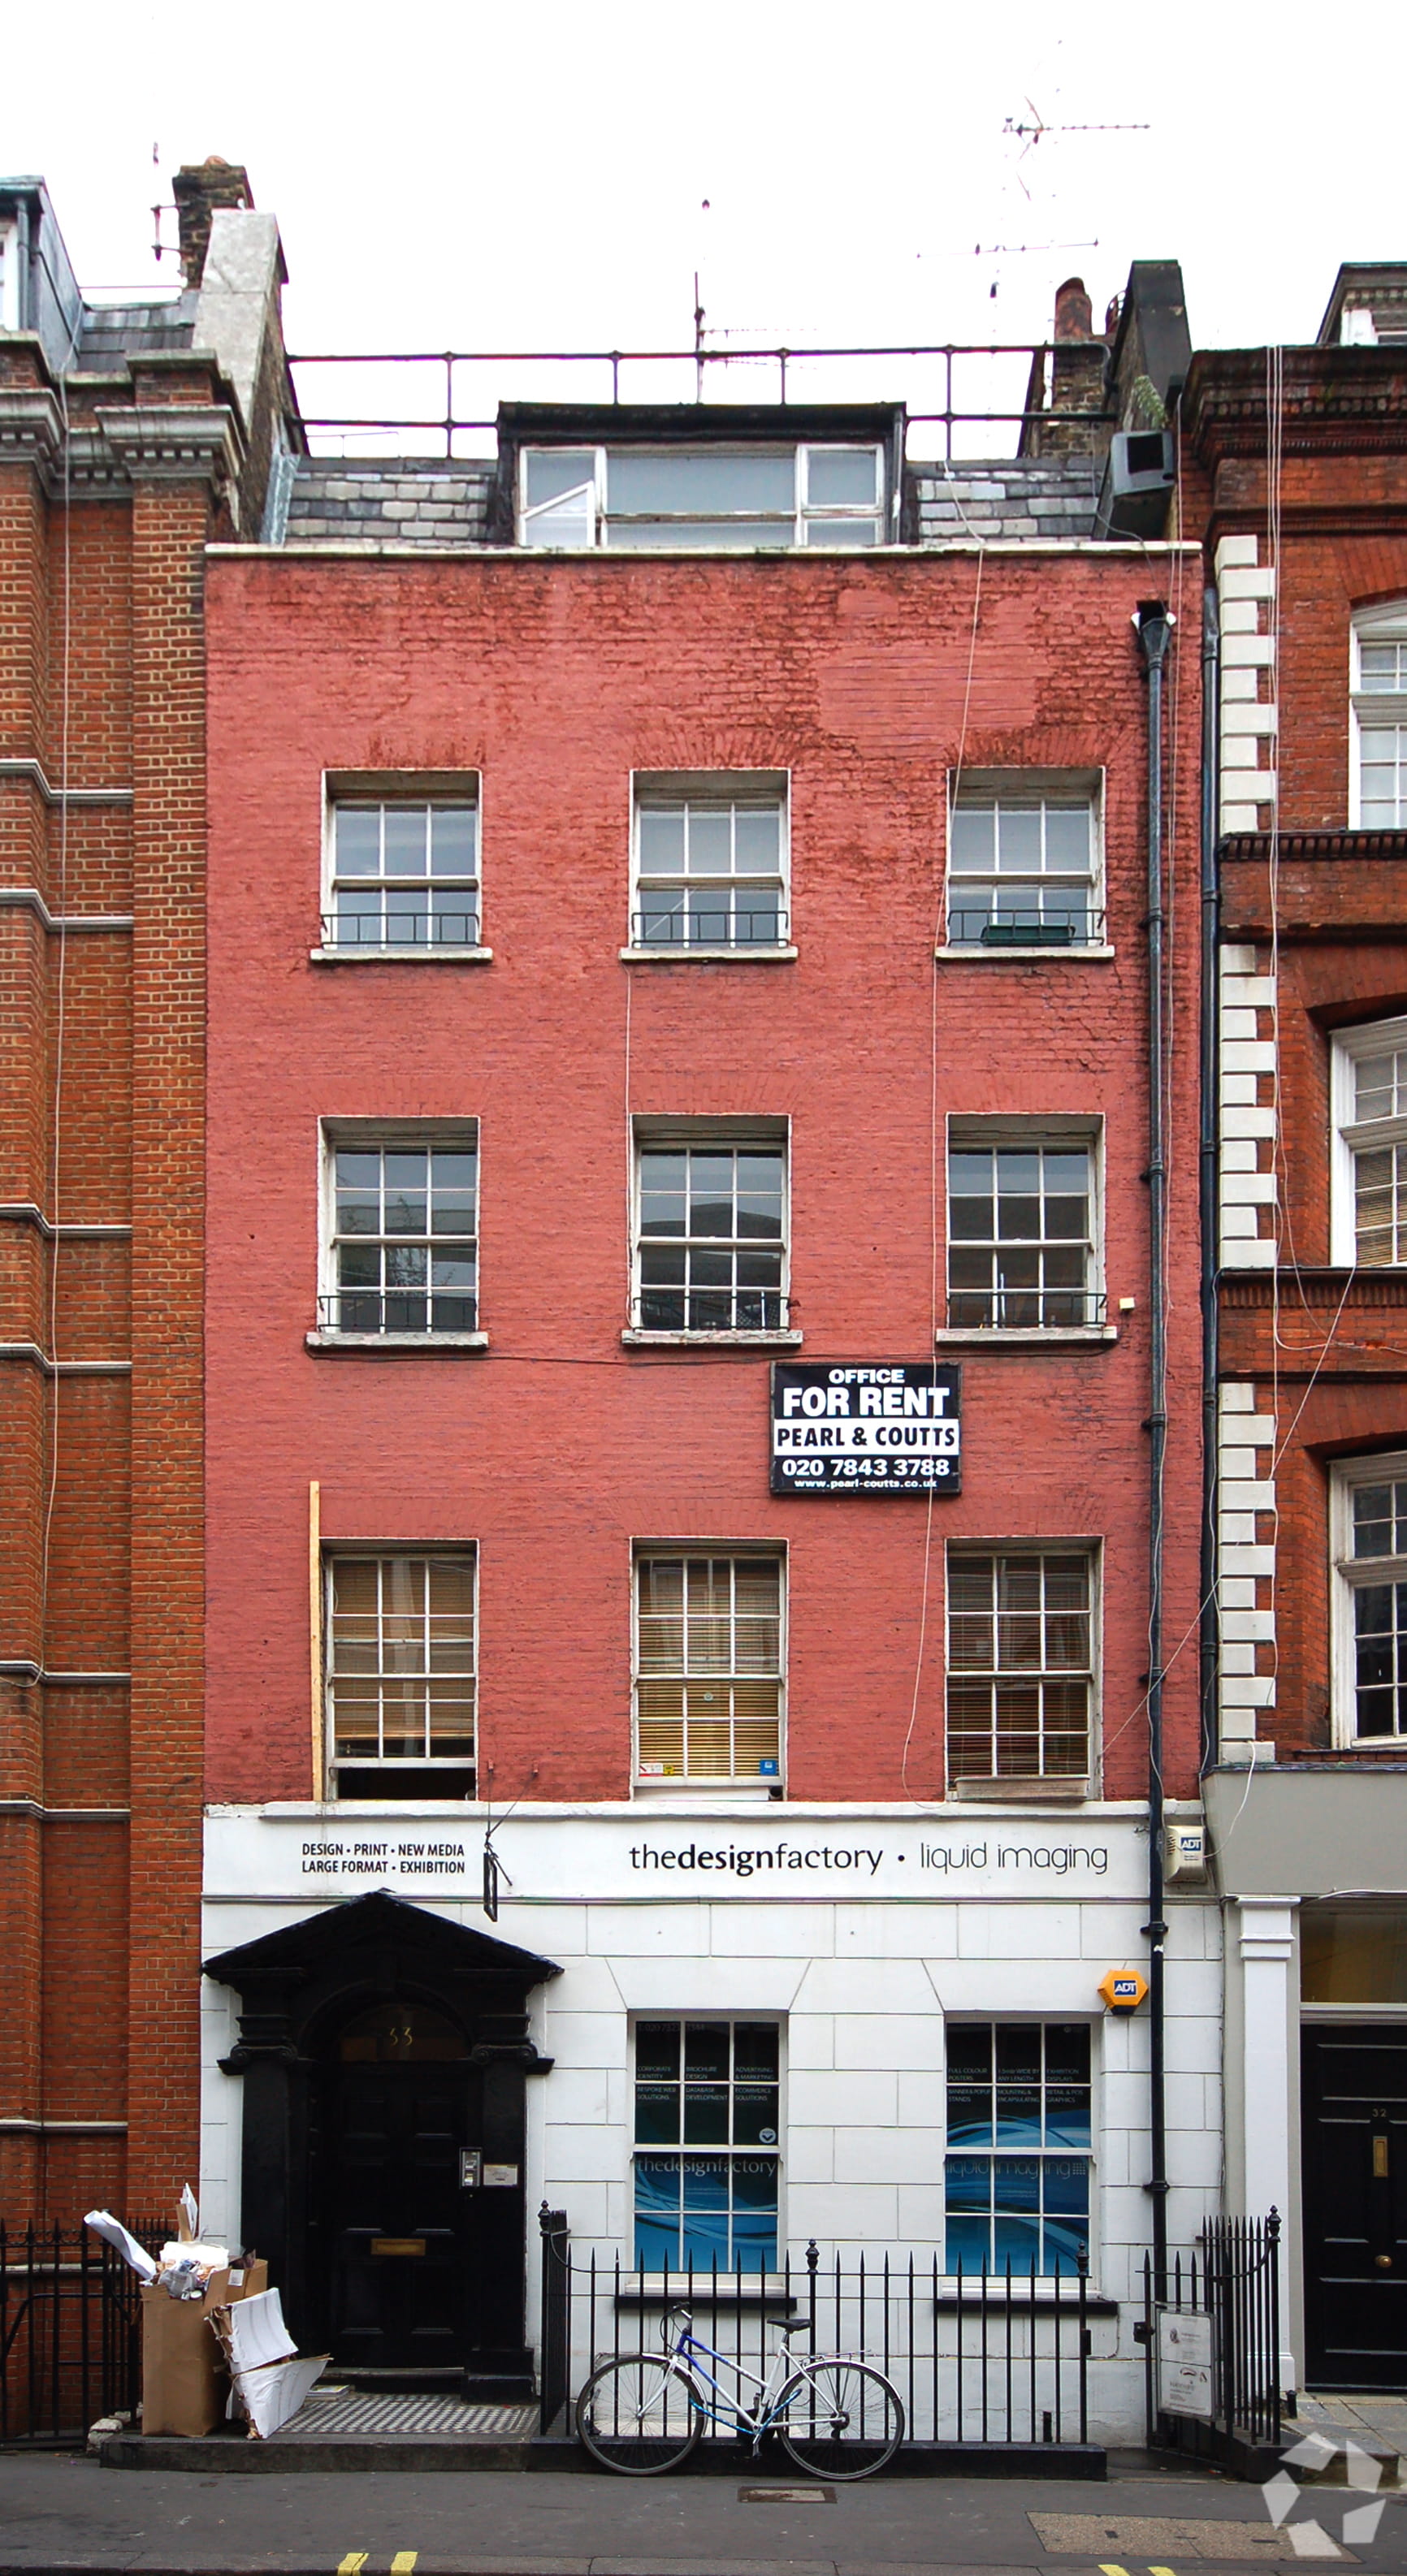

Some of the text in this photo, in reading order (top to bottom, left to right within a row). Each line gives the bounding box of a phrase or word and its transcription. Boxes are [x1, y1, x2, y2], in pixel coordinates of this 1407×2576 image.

[829, 1369, 905, 1384] OFFICE
[783, 1386, 950, 1416] FOR RENT
[777, 1427, 955, 1446] PEARL & COUTTS
[782, 1459, 950, 1476] 020 7843 3788
[794, 1478, 937, 1489] www.pearl-coutts.co.uk
[302, 1843, 465, 1856] DESIGN PRINT NEW MEDIA
[1182, 1839, 1201, 1848] ADT
[629, 1842, 1108, 1876] thedesignfactory liquid imaging
[302, 1861, 465, 1874] LARGE FORMAT EXHIBITION
[1115, 1982, 1136, 1993] ADT
[1372, 2107, 1387, 2117] 32
[638, 2157, 777, 2177] thedesignfactory
[946, 2159, 1071, 2180] liquid imaging
